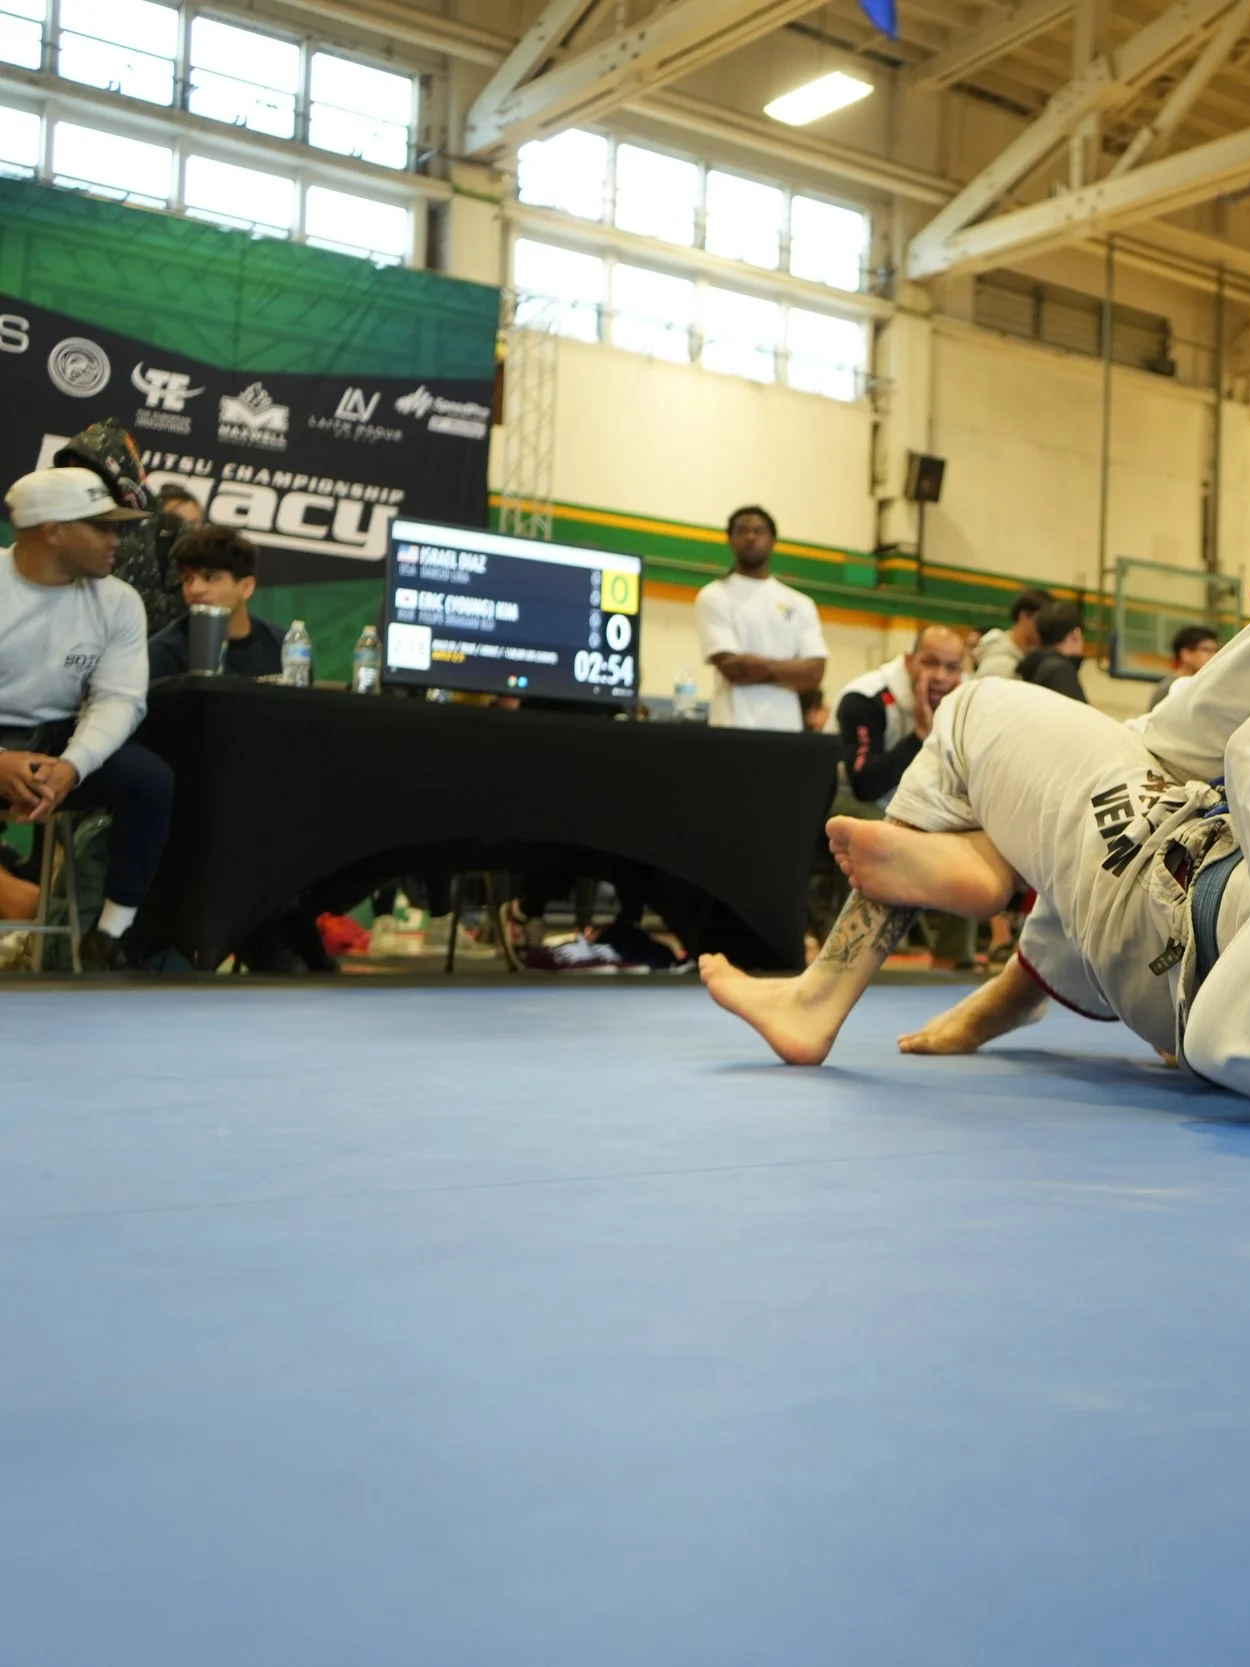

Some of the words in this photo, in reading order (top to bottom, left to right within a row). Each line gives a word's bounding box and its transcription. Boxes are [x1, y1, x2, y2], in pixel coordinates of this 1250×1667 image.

[145, 367, 191, 412] TE
[221, 462, 405, 506] CHAMPIONSHIP
[611, 575, 629, 605] 0
[606, 613, 632, 651] 0
[574, 650, 634, 688] 02:54
